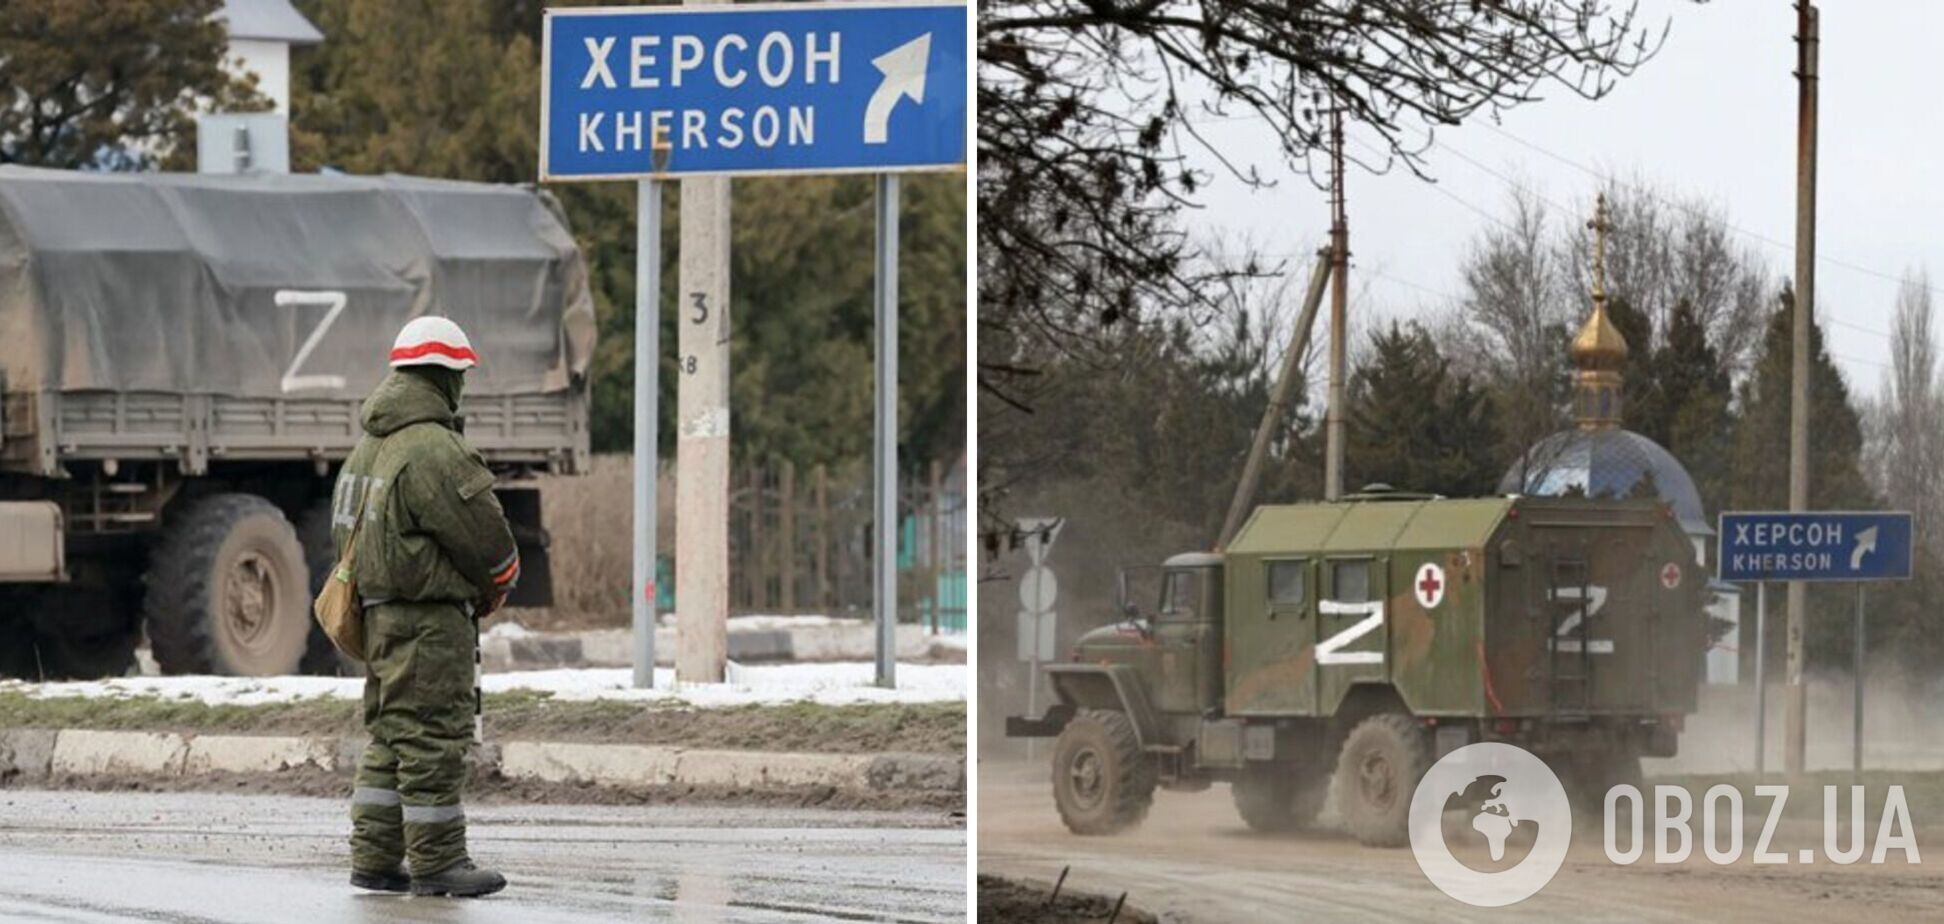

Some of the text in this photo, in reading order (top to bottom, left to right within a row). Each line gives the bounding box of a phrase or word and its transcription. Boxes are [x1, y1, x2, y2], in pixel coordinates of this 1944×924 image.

[580, 31, 841, 89] ХЕРСОН
[578, 105, 816, 152] KHERSON
[689, 292, 708, 325] 3
[274, 290, 347, 393] Z
[1735, 523, 1842, 546] ХЕРСОН
[1733, 553, 1831, 571] KHERSON
[1315, 600, 1384, 664] Z
[1547, 585, 1614, 653] Z
